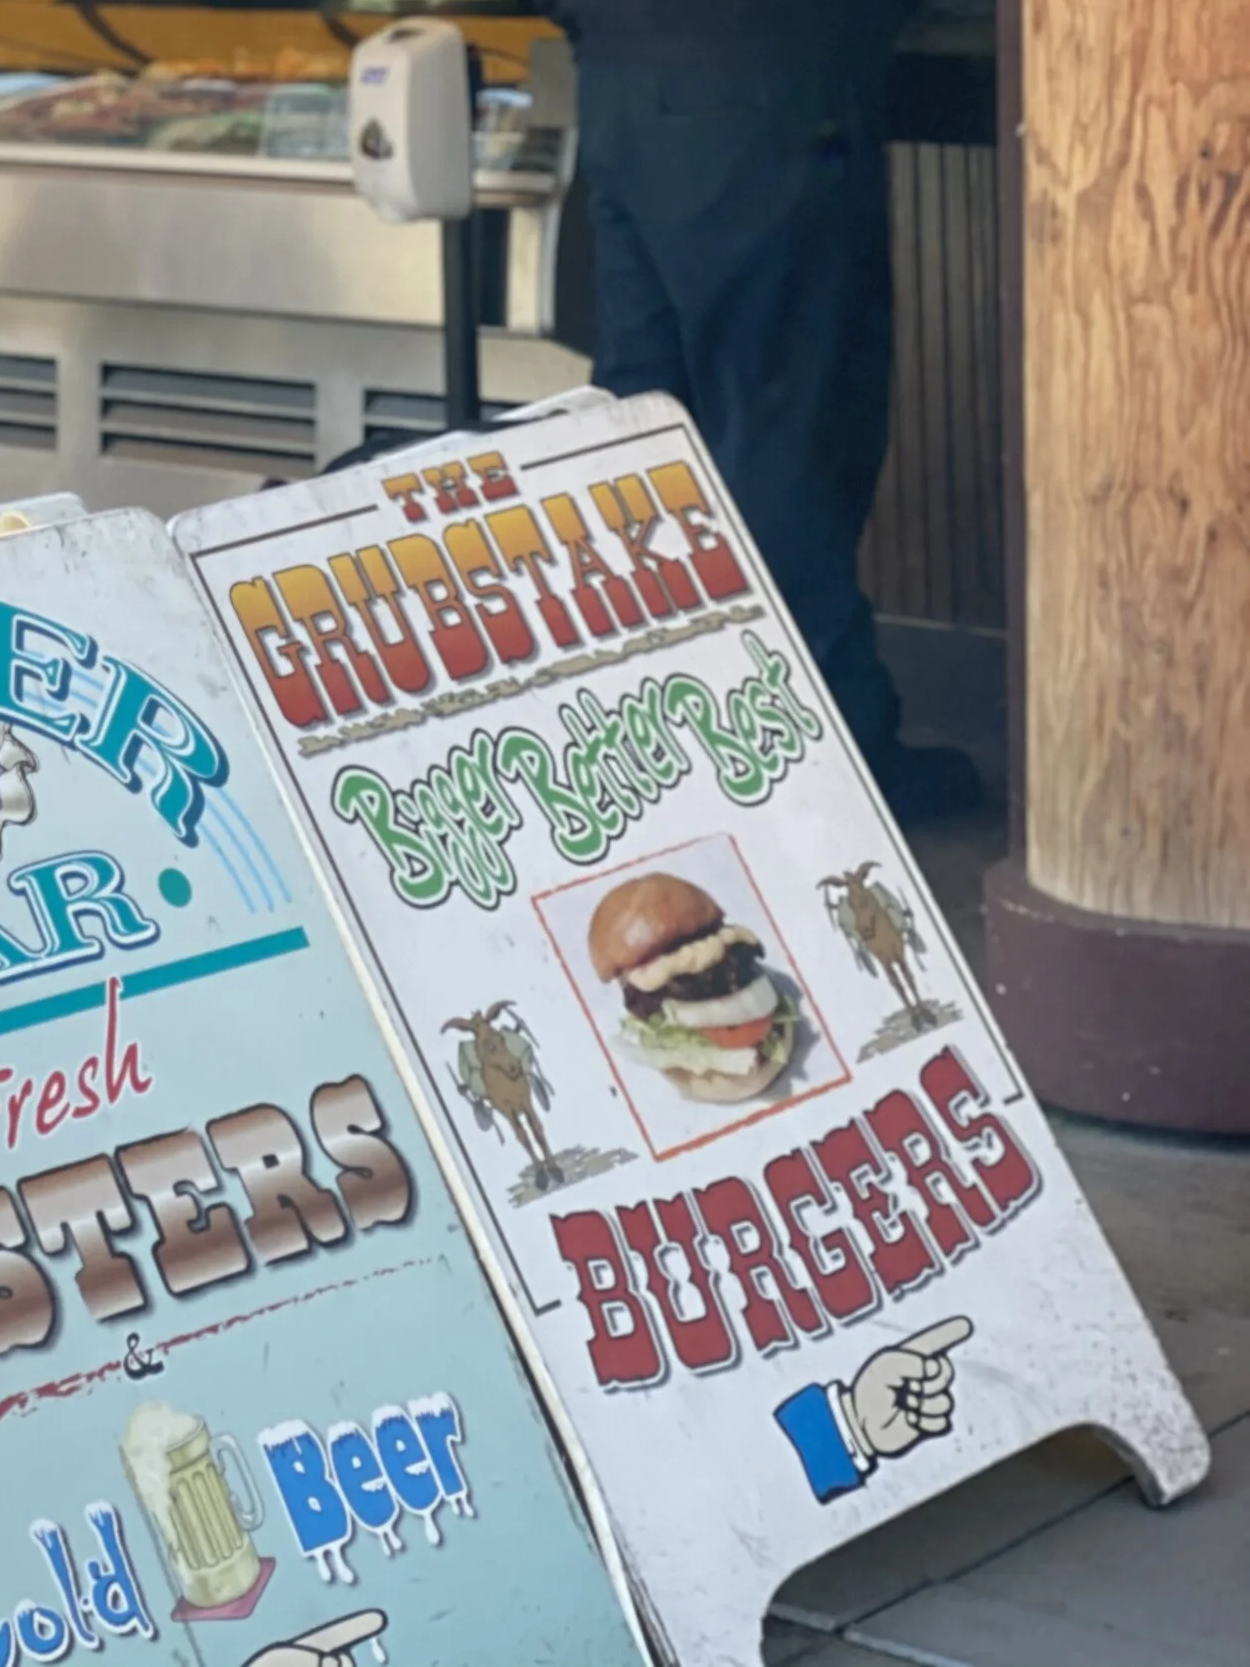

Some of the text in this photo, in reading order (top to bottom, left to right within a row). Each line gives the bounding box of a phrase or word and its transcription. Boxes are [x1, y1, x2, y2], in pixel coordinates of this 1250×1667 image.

[228, 459, 755, 729] GRUBSTAKE
[381, 450, 520, 523] THE
[332, 630, 823, 909] Bigger Better Best
[549, 1044, 1043, 1393] BURGERS
[122, 1332, 164, 1379] &
[258, 1390, 474, 1586] Beer
